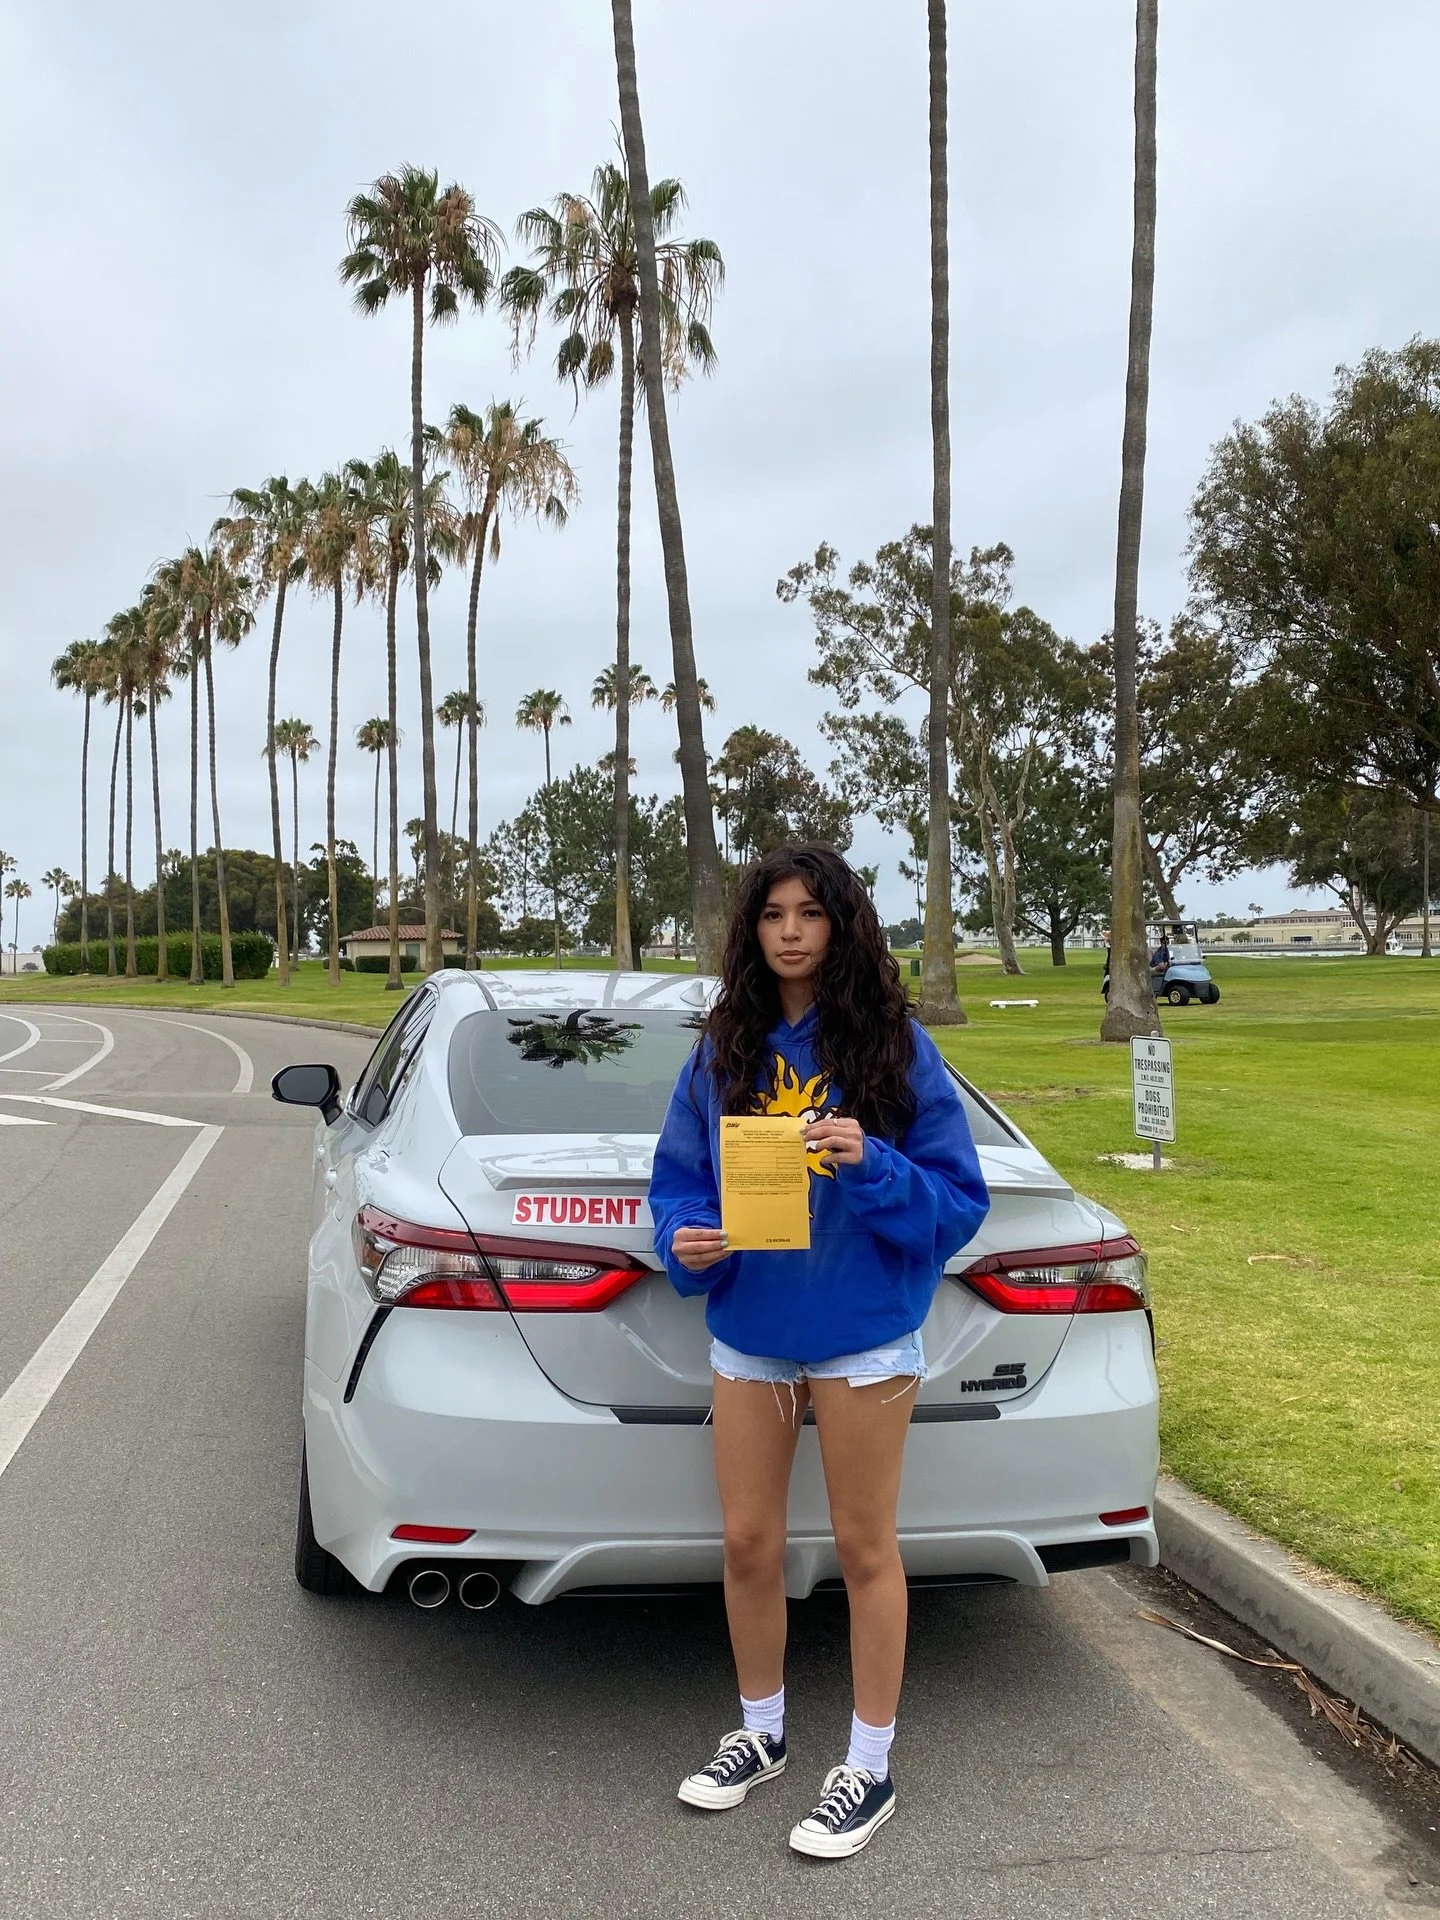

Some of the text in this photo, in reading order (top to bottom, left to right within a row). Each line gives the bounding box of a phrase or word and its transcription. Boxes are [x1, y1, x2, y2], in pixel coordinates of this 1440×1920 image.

[1147, 1045, 1155, 1056] NO
[1134, 1059, 1170, 1073] TRESPASSING
[1145, 1090, 1160, 1102] DOGS
[1138, 1102, 1169, 1117] PROHIBITED
[515, 1196, 642, 1225] STUDENT
[992, 1363, 1026, 1376] SE
[960, 1377, 1018, 1393] HYBRID
